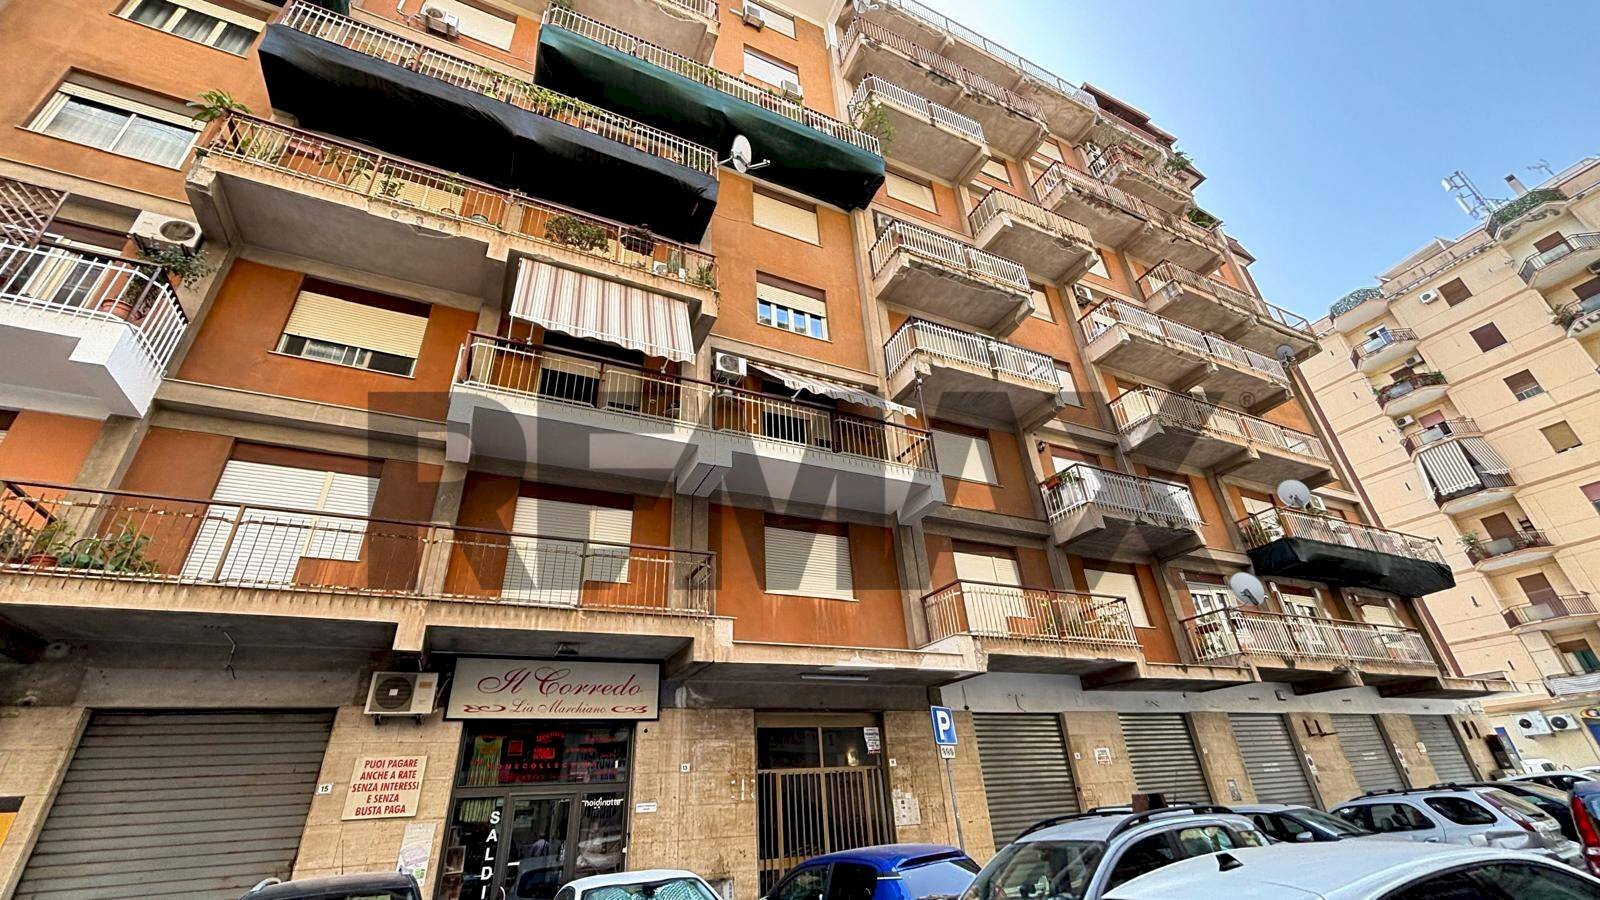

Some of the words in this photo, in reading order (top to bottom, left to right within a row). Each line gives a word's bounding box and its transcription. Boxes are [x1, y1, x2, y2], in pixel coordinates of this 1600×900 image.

[477, 667, 531, 694] Il
[534, 666, 641, 697] Corredo
[509, 699, 534, 713] Lia
[537, 699, 606, 713] Marchiano
[936, 710, 950, 740] P
[364, 759, 386, 769] PUOI
[387, 758, 418, 768] PAGARE
[360, 771, 388, 780] ANCHE
[389, 770, 395, 779] A
[397, 770, 417, 779] RATE
[352, 783, 378, 792] SENZA
[380, 782, 419, 791] INTERESSI
[366, 794, 372, 804] E
[373, 793, 399, 803] SENZA
[354, 806, 381, 816] BUSTA
[383, 804, 406, 814] PAGA
[481, 811, 500, 900] SALDI
